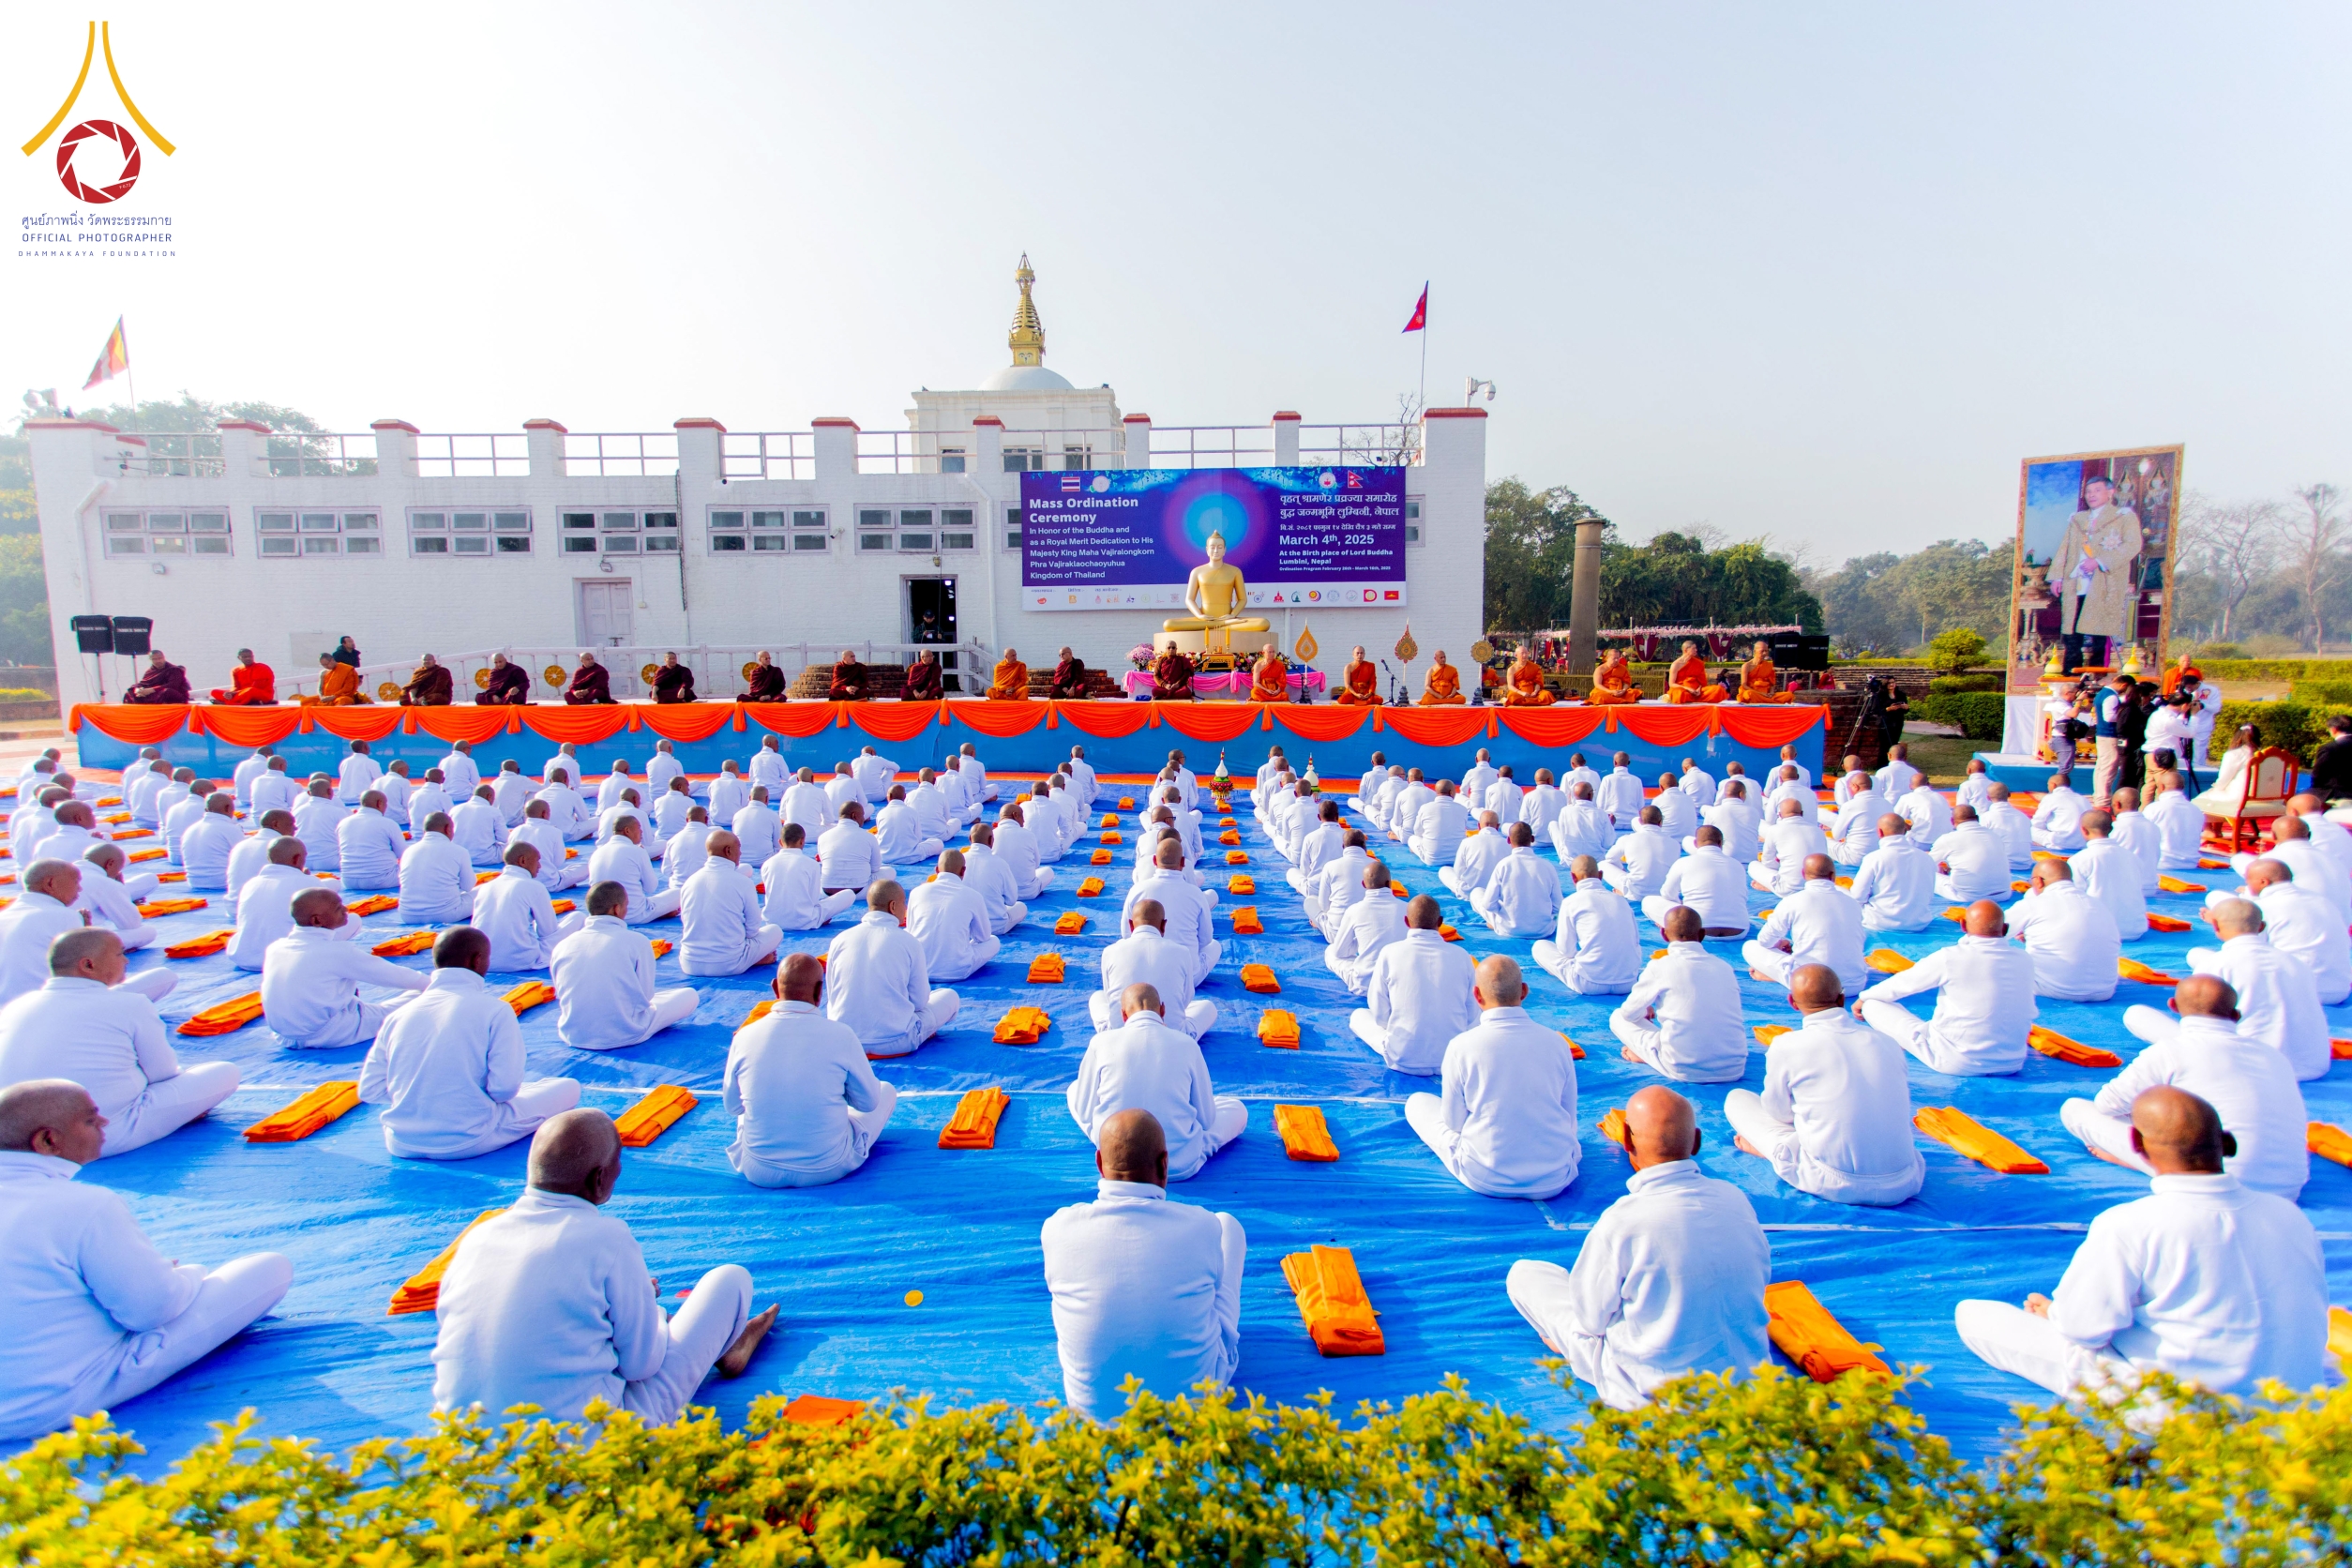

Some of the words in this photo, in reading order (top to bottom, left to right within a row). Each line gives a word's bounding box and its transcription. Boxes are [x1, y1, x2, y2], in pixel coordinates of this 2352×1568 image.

[1364, 492, 1397, 503] समारोह
[1030, 499, 1063, 509] Mass
[1067, 498, 1138, 508] Ordination
[1297, 506, 1334, 519] जन्मभूमि
[1374, 506, 1399, 516] नेपाल
[1030, 513, 1096, 524] Ceremony
[1047, 538, 1067, 547] Royal
[1279, 535, 1318, 545] March
[1321, 535, 1340, 546] 4th,
[1345, 535, 1374, 545] 2025
[1030, 550, 1059, 558] Majesty
[1031, 572, 1063, 580] Kingdom
